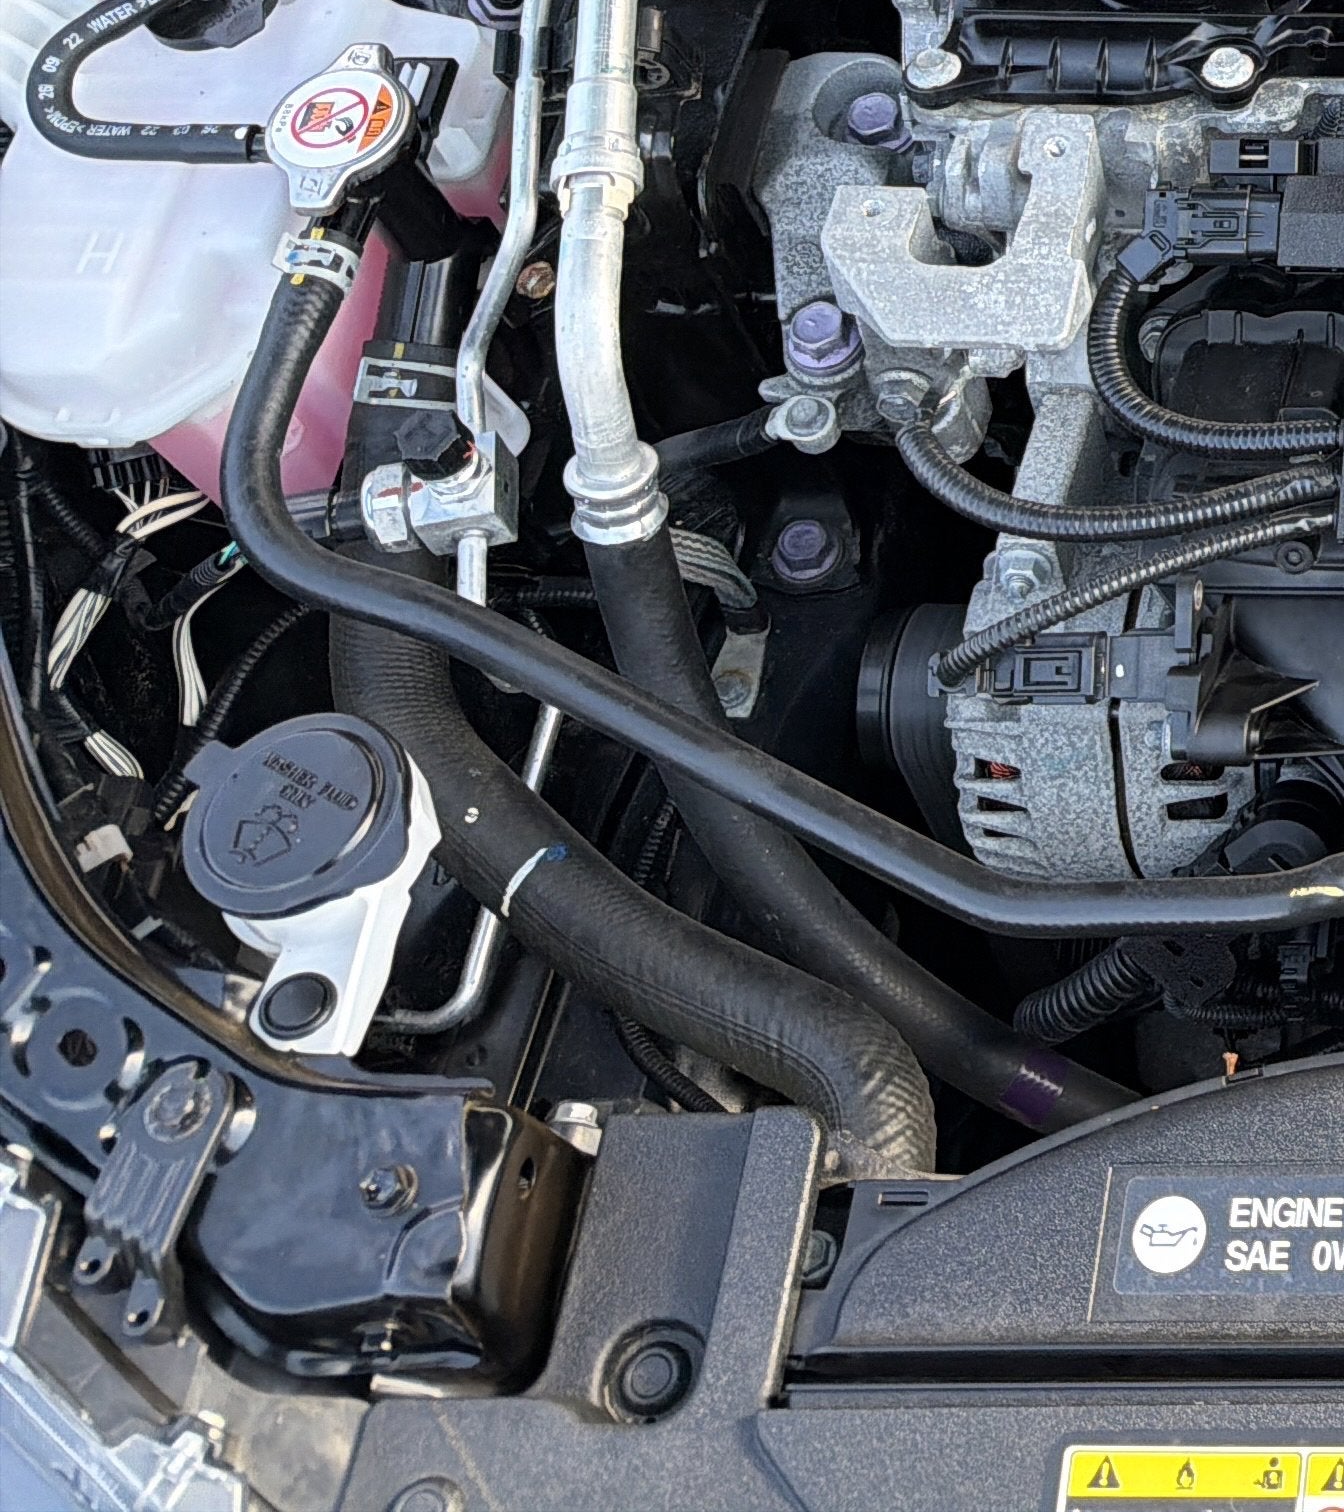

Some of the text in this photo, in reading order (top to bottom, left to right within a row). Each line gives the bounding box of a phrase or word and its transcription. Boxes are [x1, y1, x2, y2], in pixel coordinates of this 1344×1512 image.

[87, 2, 138, 34] WATER
[63, 32, 84, 50] 22
[87, 124, 131, 137] WATER
[262, 750, 319, 789] WASHER
[1229, 1197, 1344, 1228] ENGINE
[1224, 1240, 1290, 1272] SAE
